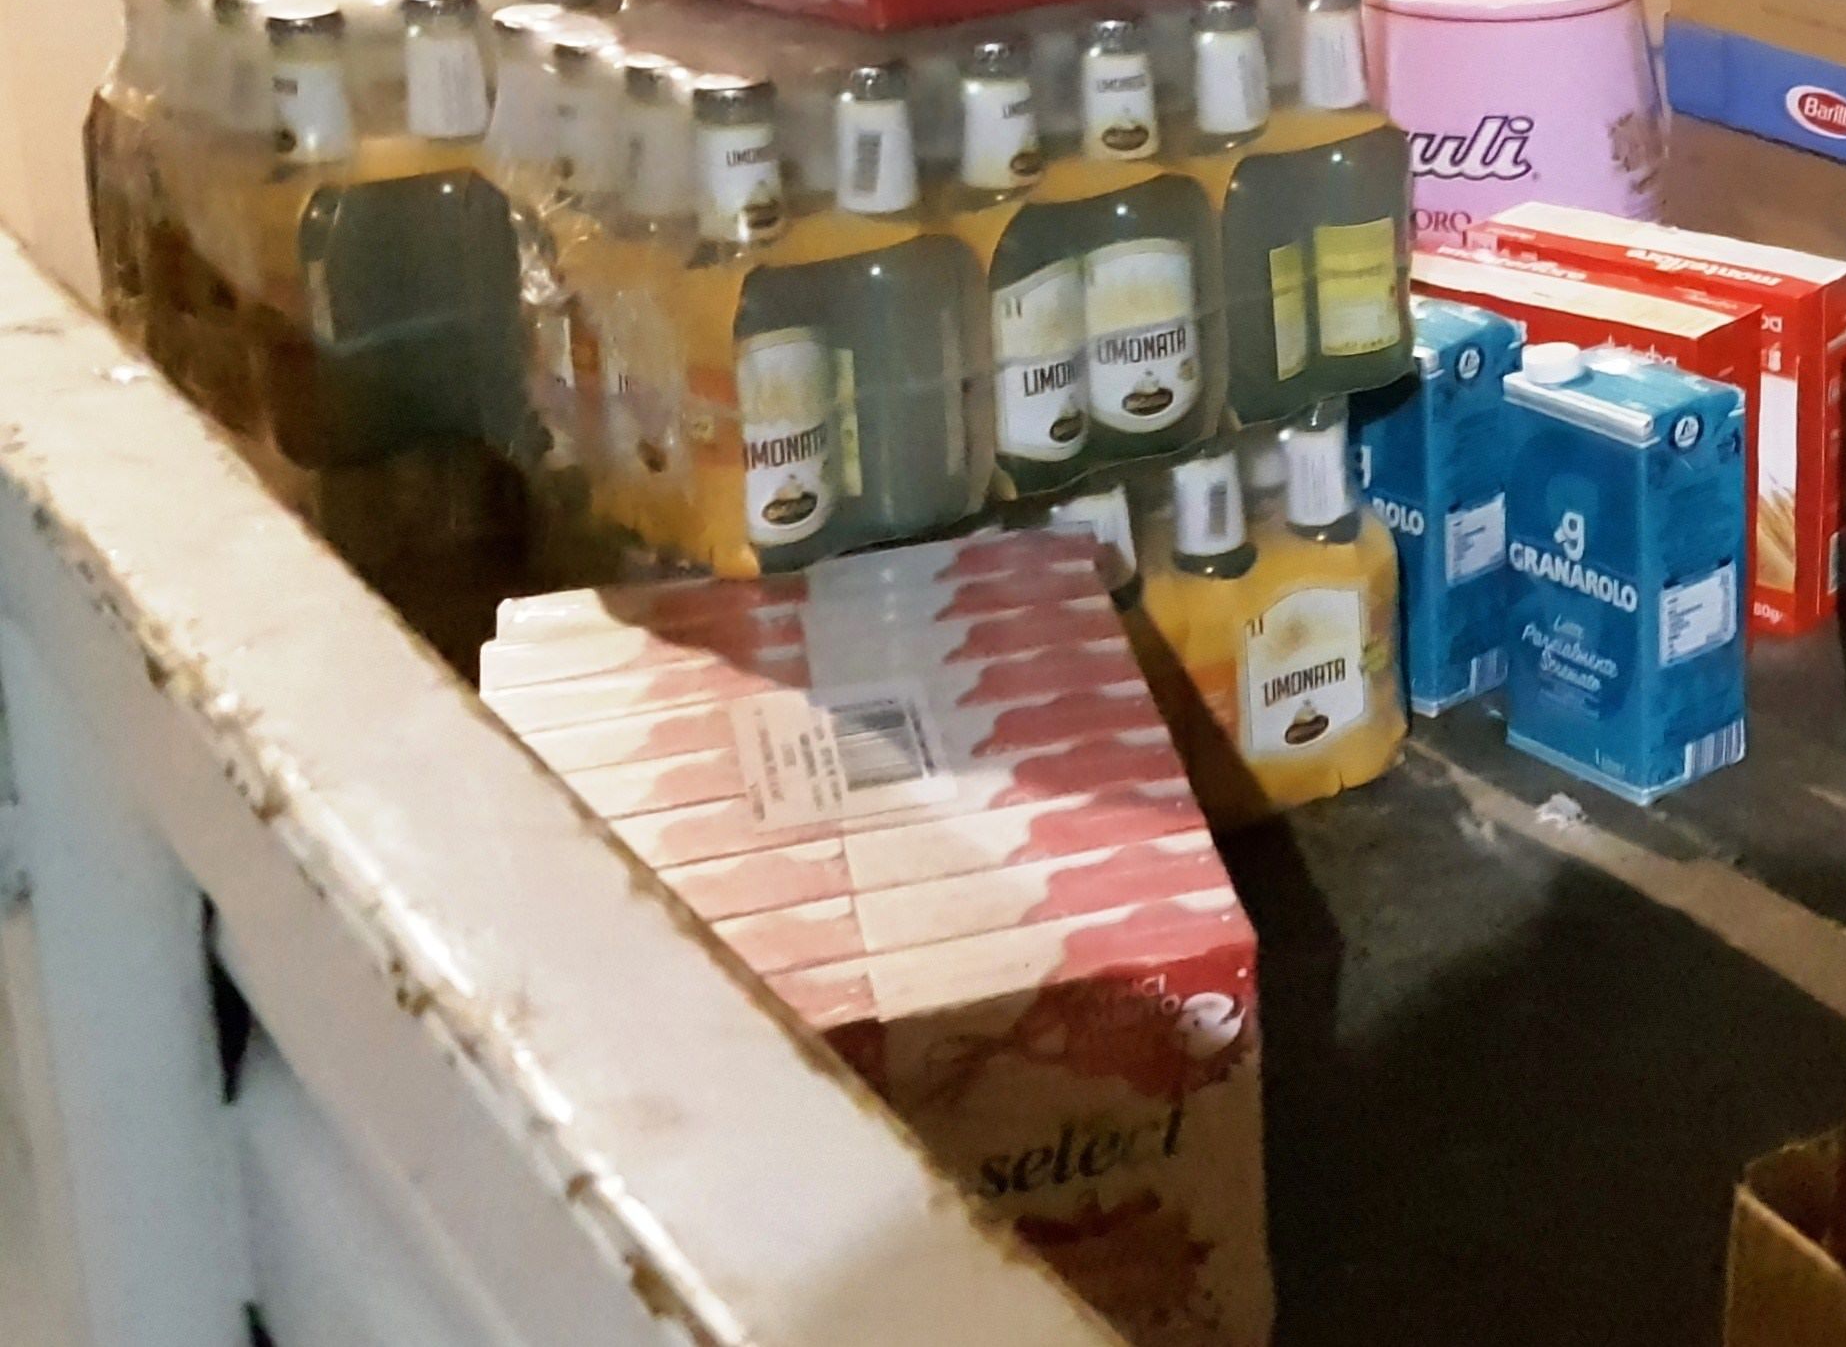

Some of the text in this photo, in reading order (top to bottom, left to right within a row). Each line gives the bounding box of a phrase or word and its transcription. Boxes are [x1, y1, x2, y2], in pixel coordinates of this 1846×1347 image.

[1097, 322, 1188, 366] LIMONATA
[1509, 542, 1638, 612] GRANAROLO
[1263, 656, 1346, 708] LIMONATA
